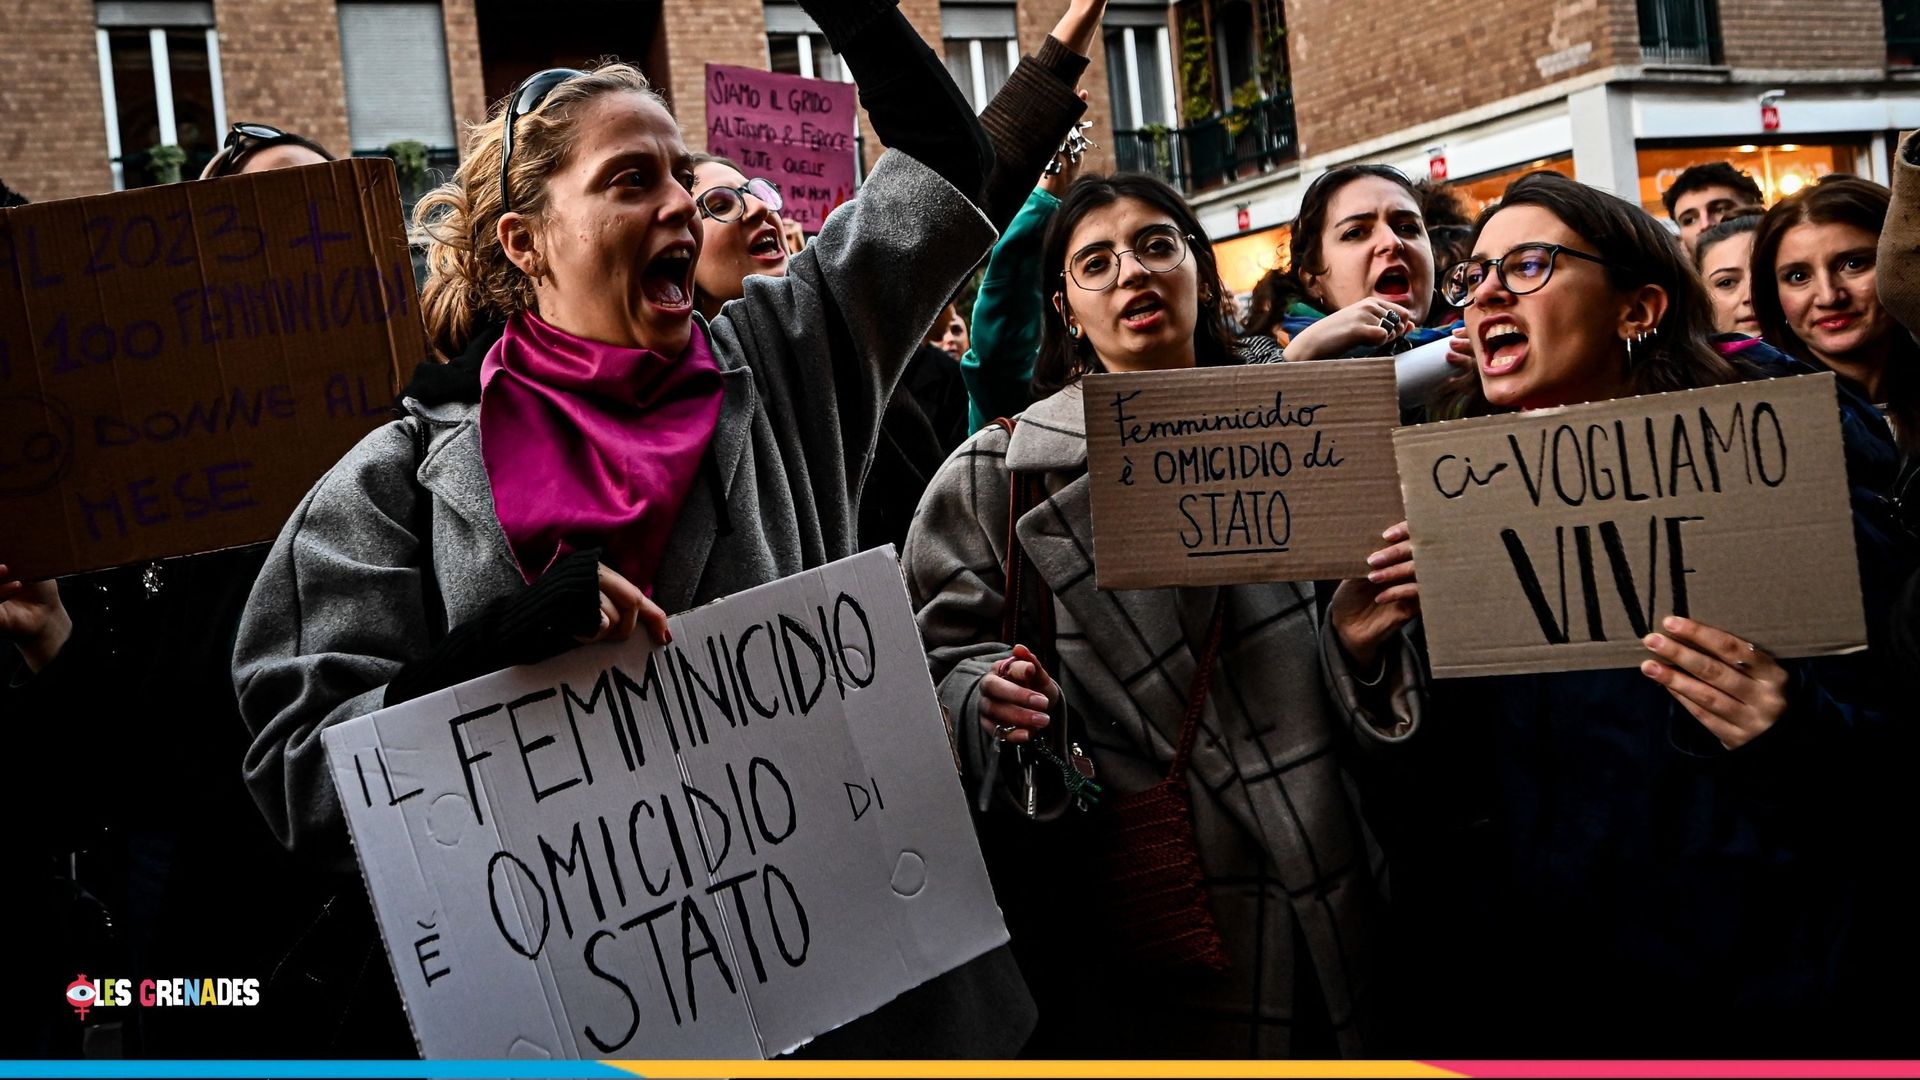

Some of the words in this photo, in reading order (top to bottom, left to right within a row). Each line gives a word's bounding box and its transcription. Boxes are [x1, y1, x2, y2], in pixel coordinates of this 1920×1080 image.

[711, 71, 761, 109] SIAMO
[788, 88, 832, 115] GRIDO
[740, 149, 773, 171] TUTTE
[783, 157, 826, 178] QUELLE
[83, 204, 267, 276] 2023
[43, 312, 165, 376] 100
[93, 383, 297, 447] DONNE
[325, 373, 396, 420] AL
[1110, 390, 1328, 446] Femminicidio
[1118, 456, 1134, 486] è
[1154, 441, 1292, 485] OMICIDIO
[1303, 431, 1344, 468] di
[1508, 401, 1787, 506] VOGLIAMO
[77, 460, 258, 541] MESE
[1179, 489, 1291, 549] STATO
[354, 748, 424, 808] IL
[449, 591, 876, 825] FEMMINICIDIO
[487, 756, 798, 960] OMICIDIO
[844, 777, 884, 821] DI
[583, 863, 809, 1054] STATO
